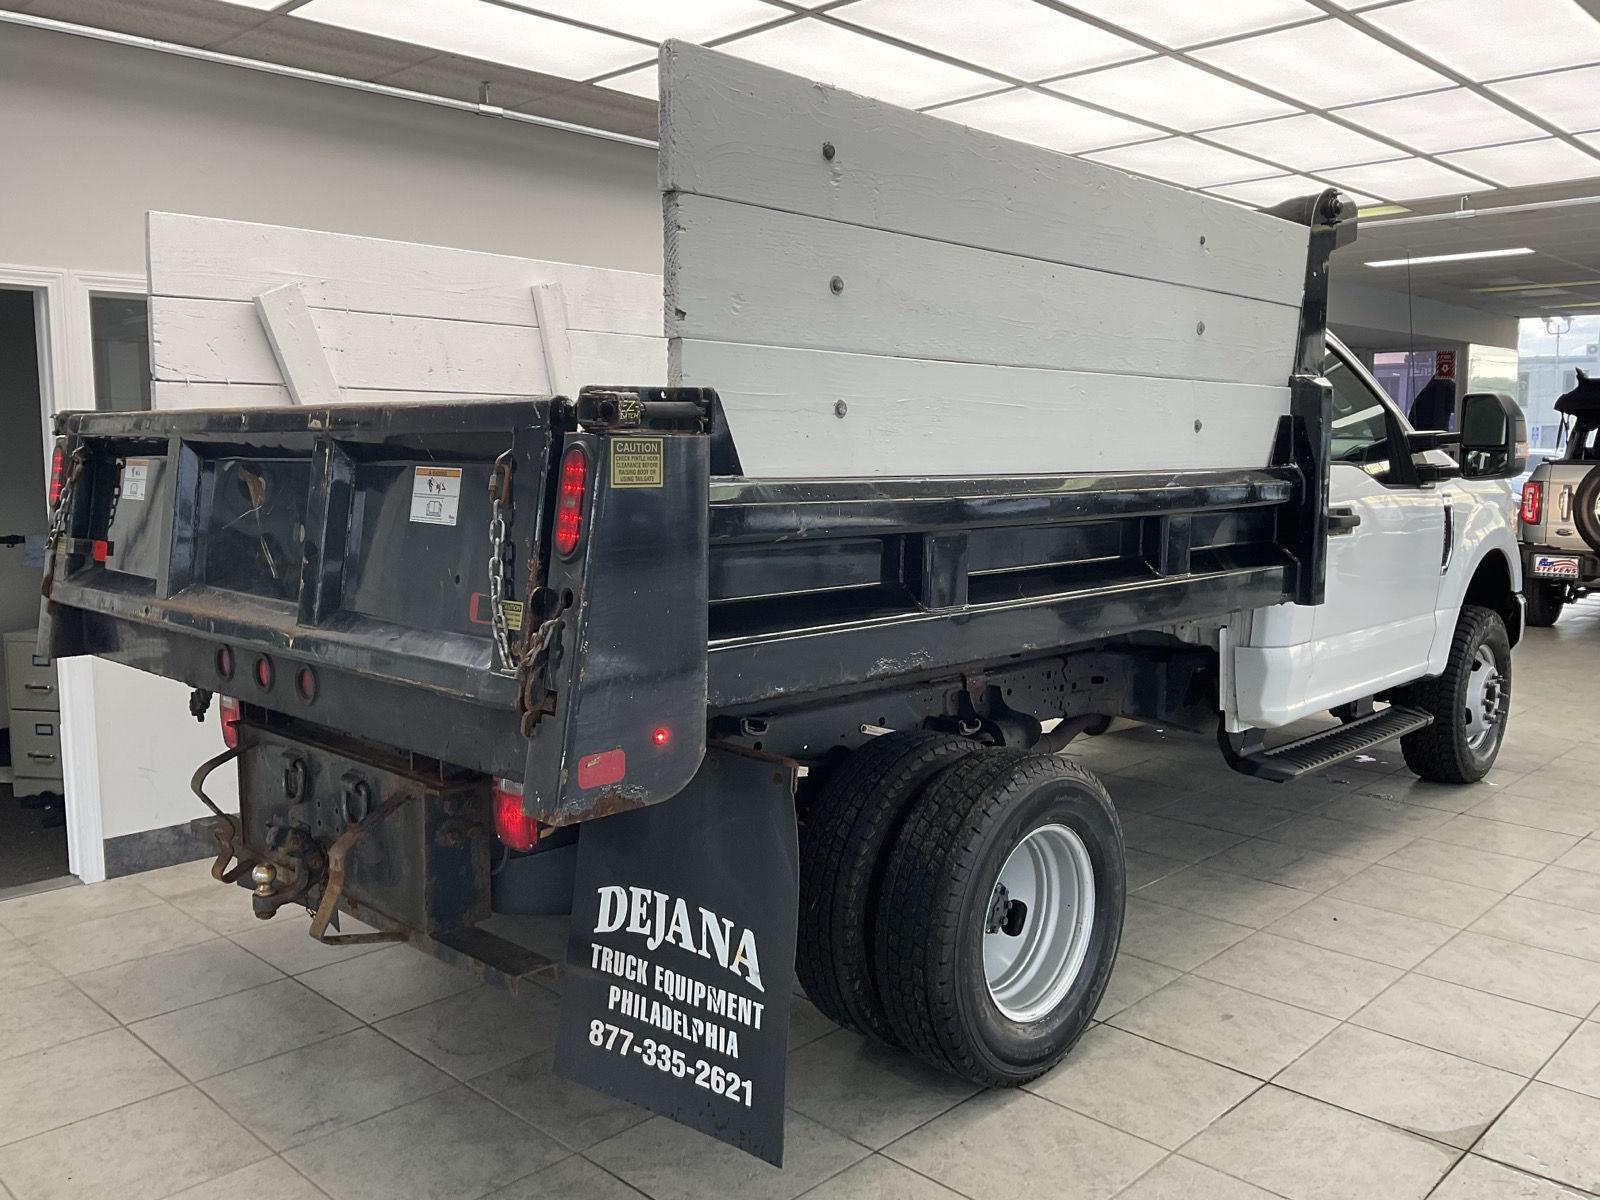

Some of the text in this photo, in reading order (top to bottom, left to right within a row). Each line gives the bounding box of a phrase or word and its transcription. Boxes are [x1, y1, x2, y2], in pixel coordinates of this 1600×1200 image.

[616, 442, 658, 453] CAUTION
[1536, 566, 1577, 574] STEVENS
[593, 885, 765, 993] DEJANA
[591, 943, 765, 1030] TRUCK EQUIPMENT
[608, 985, 739, 1059] PHILADELPHIA
[588, 1019, 753, 1107] 877-335-2621
